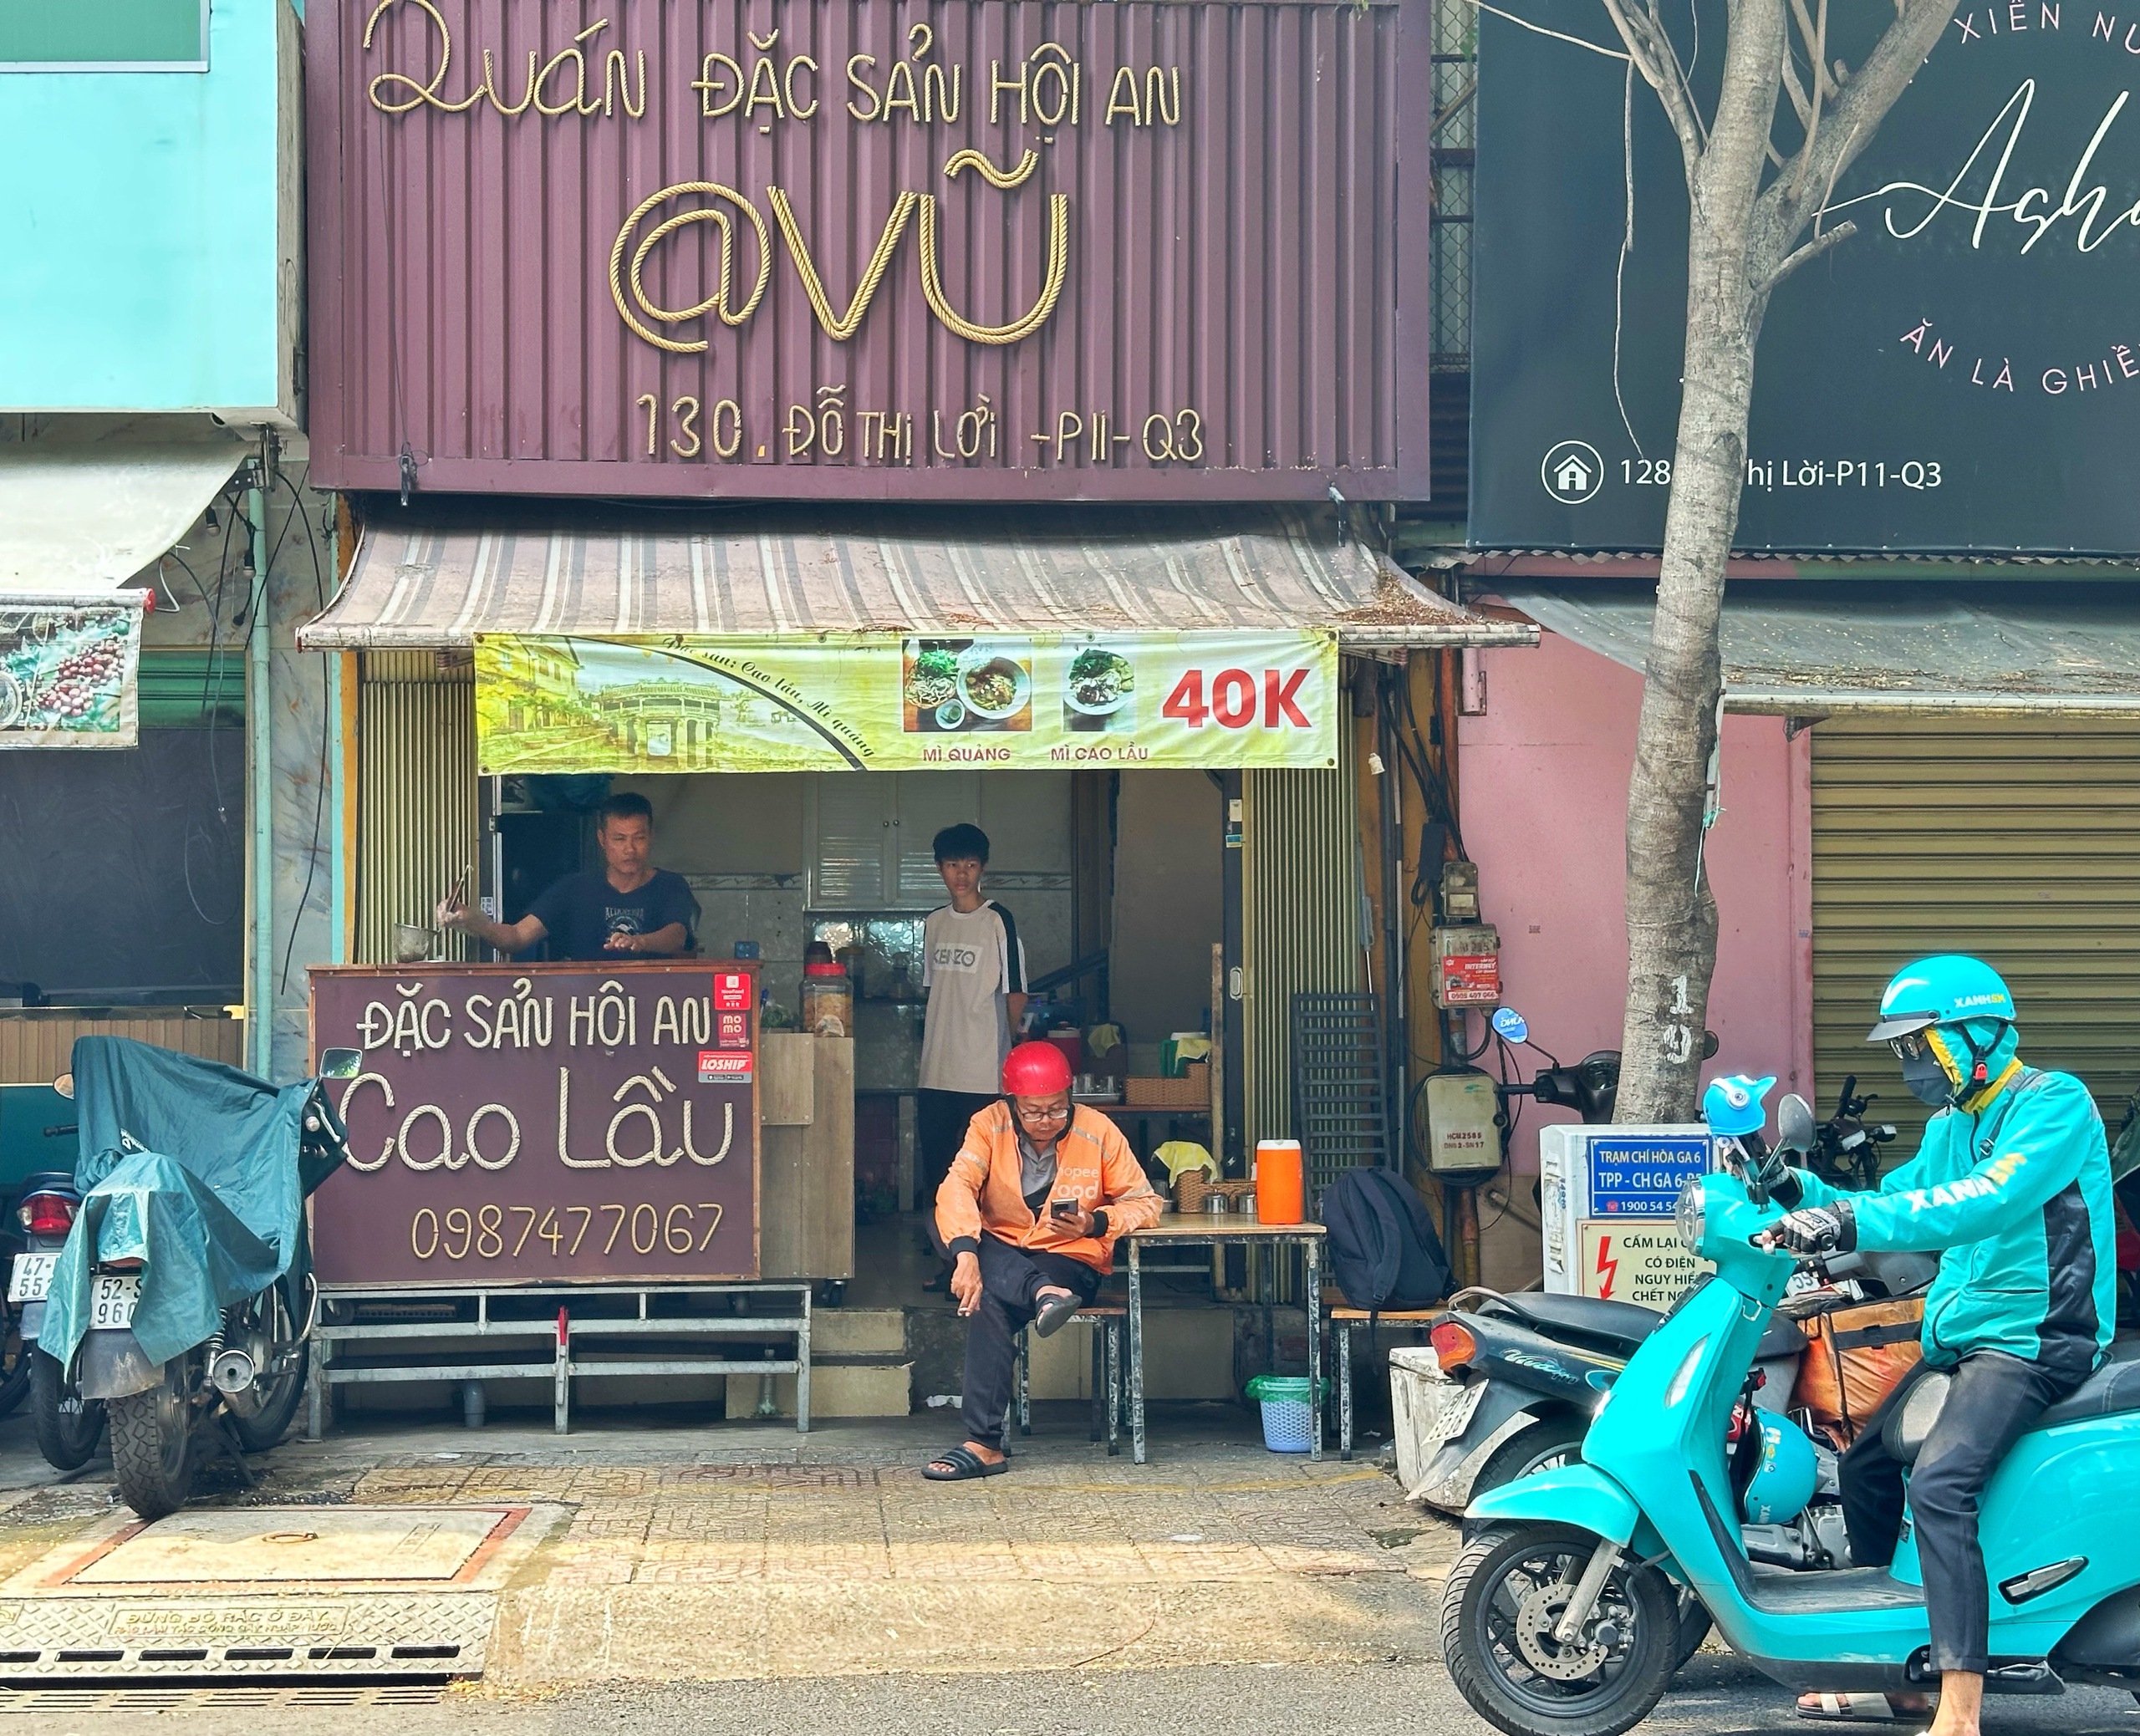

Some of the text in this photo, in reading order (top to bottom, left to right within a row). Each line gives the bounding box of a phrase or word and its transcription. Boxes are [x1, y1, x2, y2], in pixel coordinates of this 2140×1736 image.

[690, 28, 818, 134] ĐẶC
[847, 23, 961, 123] SẢN
[990, 43, 1080, 145] HỘI
[1105, 65, 1181, 125] AN
[1812, 78, 2140, 254] Ash
[1899, 317, 2140, 395] ĂN LÀ GHIỀ
[1620, 459, 1942, 492] 128 hị Lời-P11-Q3
[1162, 668, 1312, 729] 40K
[923, 743, 1011, 761] MÌ QUẢNG
[1051, 744, 1070, 761] MÌ
[1074, 746, 1113, 761] CAO
[356, 976, 711, 1058] ĐẶC SẢN HỘI AN
[701, 1059, 749, 1071] LOSHIP
[339, 1065, 734, 1172] Cao Lầu
[1598, 1148, 1701, 1166] TRẠM CHÍ HÒA GA 6
[1058, 1167, 1100, 1181] opee
[1598, 1173, 1623, 1188] TPP
[1633, 1173, 1651, 1188] CH
[1653, 1173, 1672, 1188] GA
[1052, 1179, 1099, 1200] ood
[1621, 1202, 1647, 1211] 1900
[1649, 1201, 1664, 1211] 54
[411, 1203, 724, 1260] 0987477067
[1623, 1234, 1653, 1248] CẤM
[1657, 1237, 1677, 1251] LẠI
[23, 1257, 55, 1276] 47-
[1645, 1255, 1695, 1271] CÓ ĐIỆN
[1635, 1274, 1671, 1285] NGUY
[1632, 1287, 1664, 1301] CHẾT
